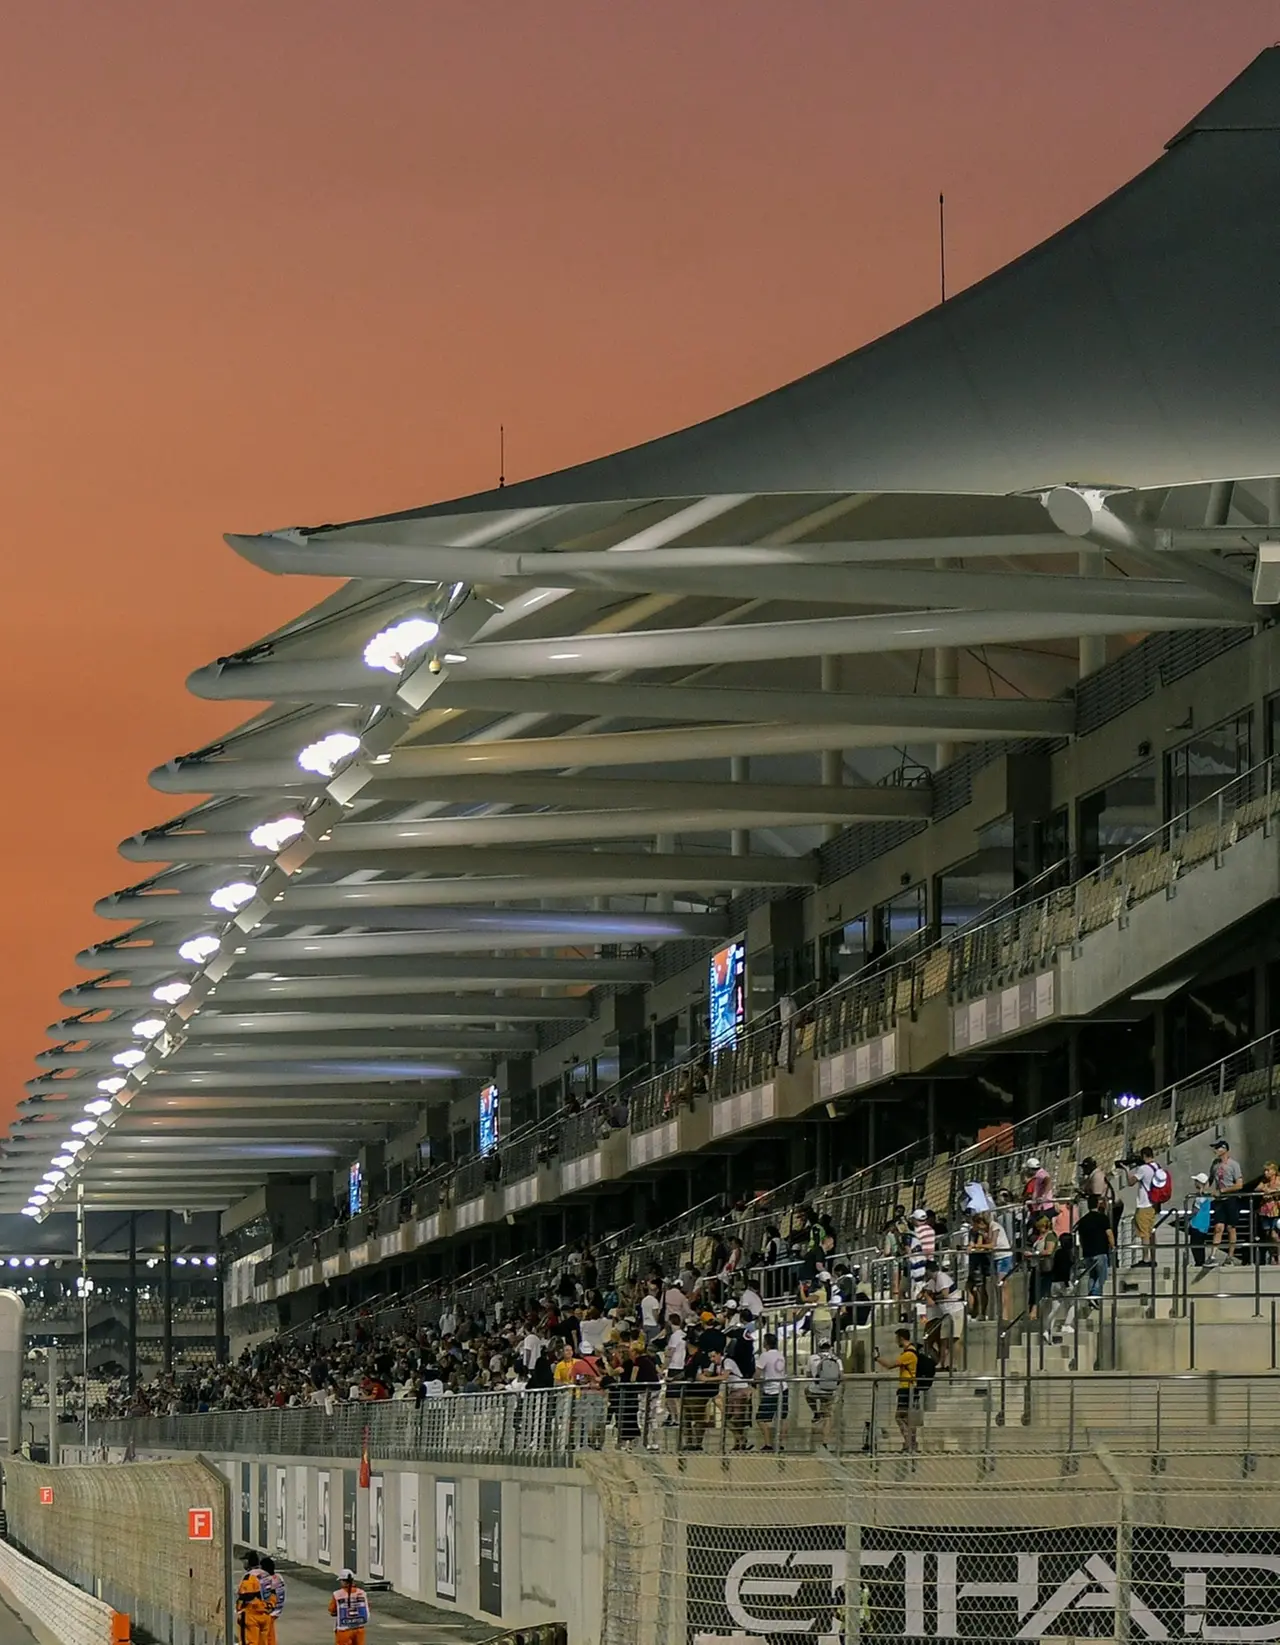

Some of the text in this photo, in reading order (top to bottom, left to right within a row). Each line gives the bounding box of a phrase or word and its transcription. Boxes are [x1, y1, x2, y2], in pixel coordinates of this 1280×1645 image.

[42, 1490, 51, 1501] F
[193, 1513, 206, 1534] F
[725, 1550, 1280, 1642] ETIHAD
